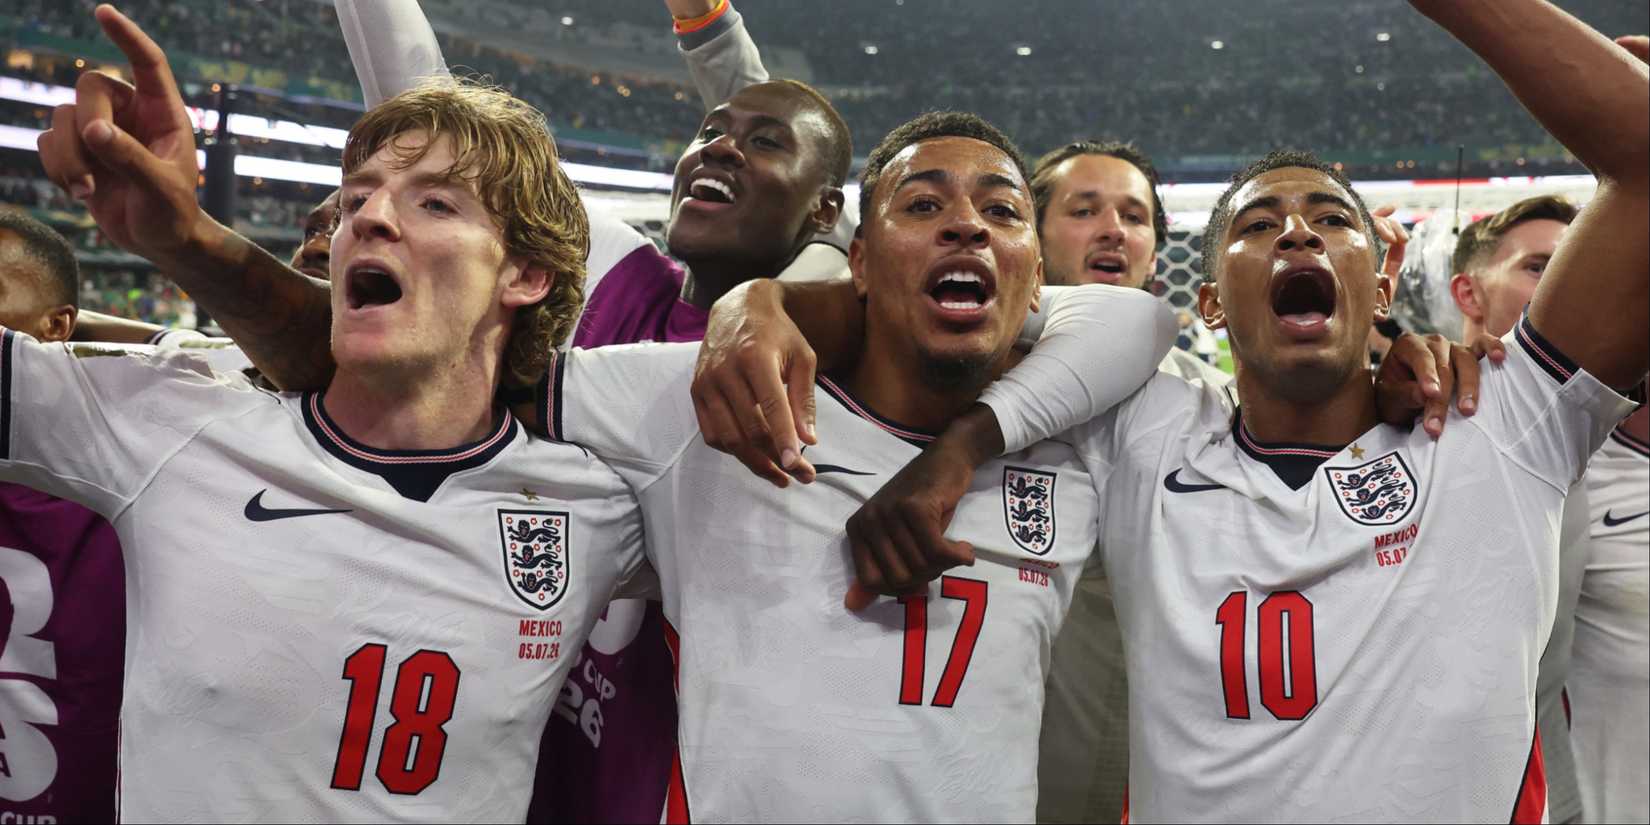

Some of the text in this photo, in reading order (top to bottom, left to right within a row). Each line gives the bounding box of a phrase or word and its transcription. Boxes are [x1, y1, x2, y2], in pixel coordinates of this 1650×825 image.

[1374, 523, 1418, 551] MEXICO
[518, 642, 560, 660] 05.07.26
[519, 619, 562, 637] MEXICO
[897, 575, 988, 708] 17
[1215, 590, 1319, 721] 10
[330, 642, 461, 796] 18
